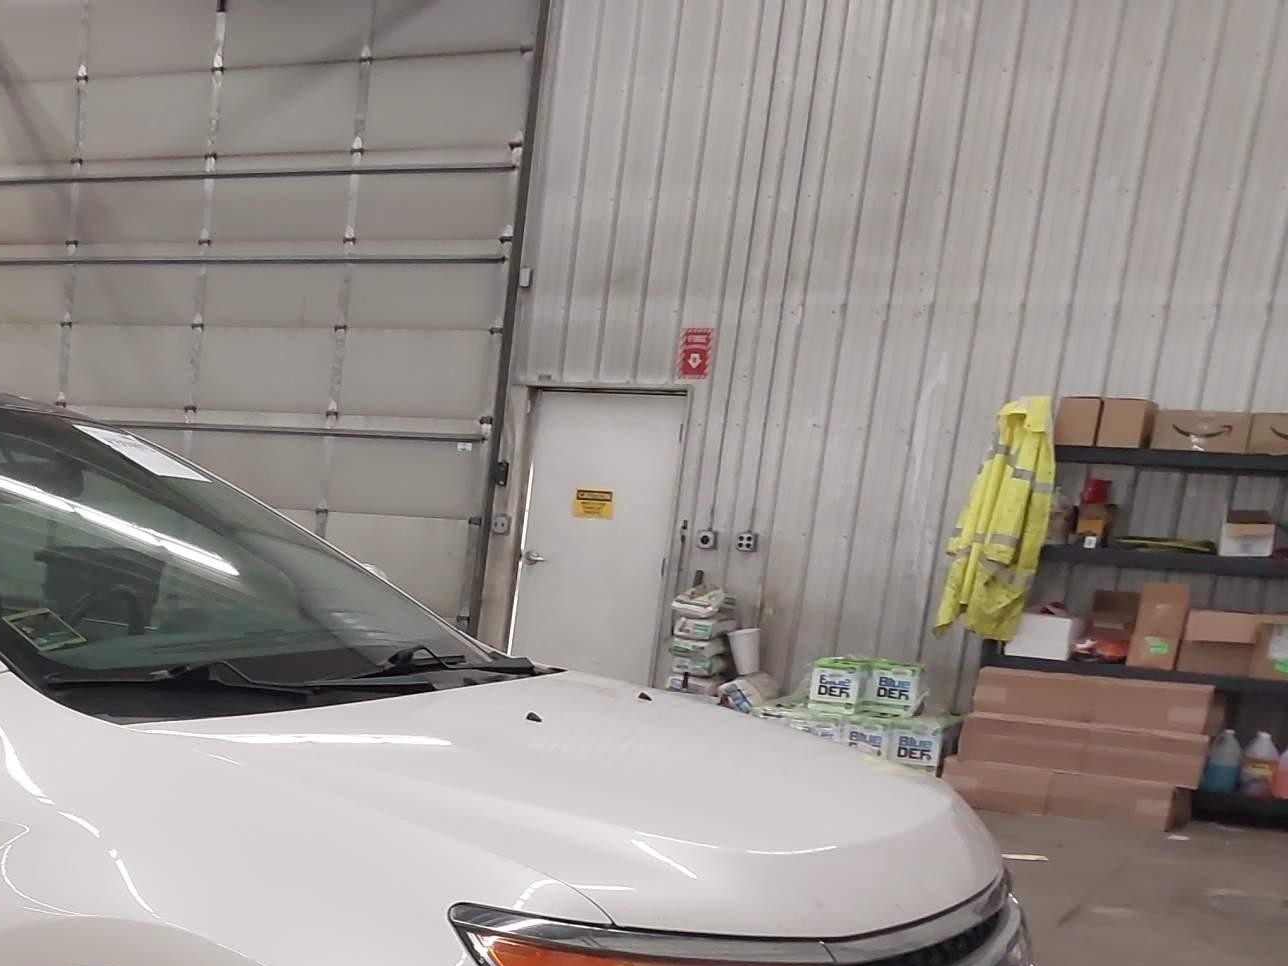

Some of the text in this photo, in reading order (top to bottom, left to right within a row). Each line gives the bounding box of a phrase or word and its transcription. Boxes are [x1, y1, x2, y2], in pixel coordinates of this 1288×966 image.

[817, 685, 850, 699] DEF
[876, 687, 909, 700] DEF
[896, 747, 932, 761] DEF
